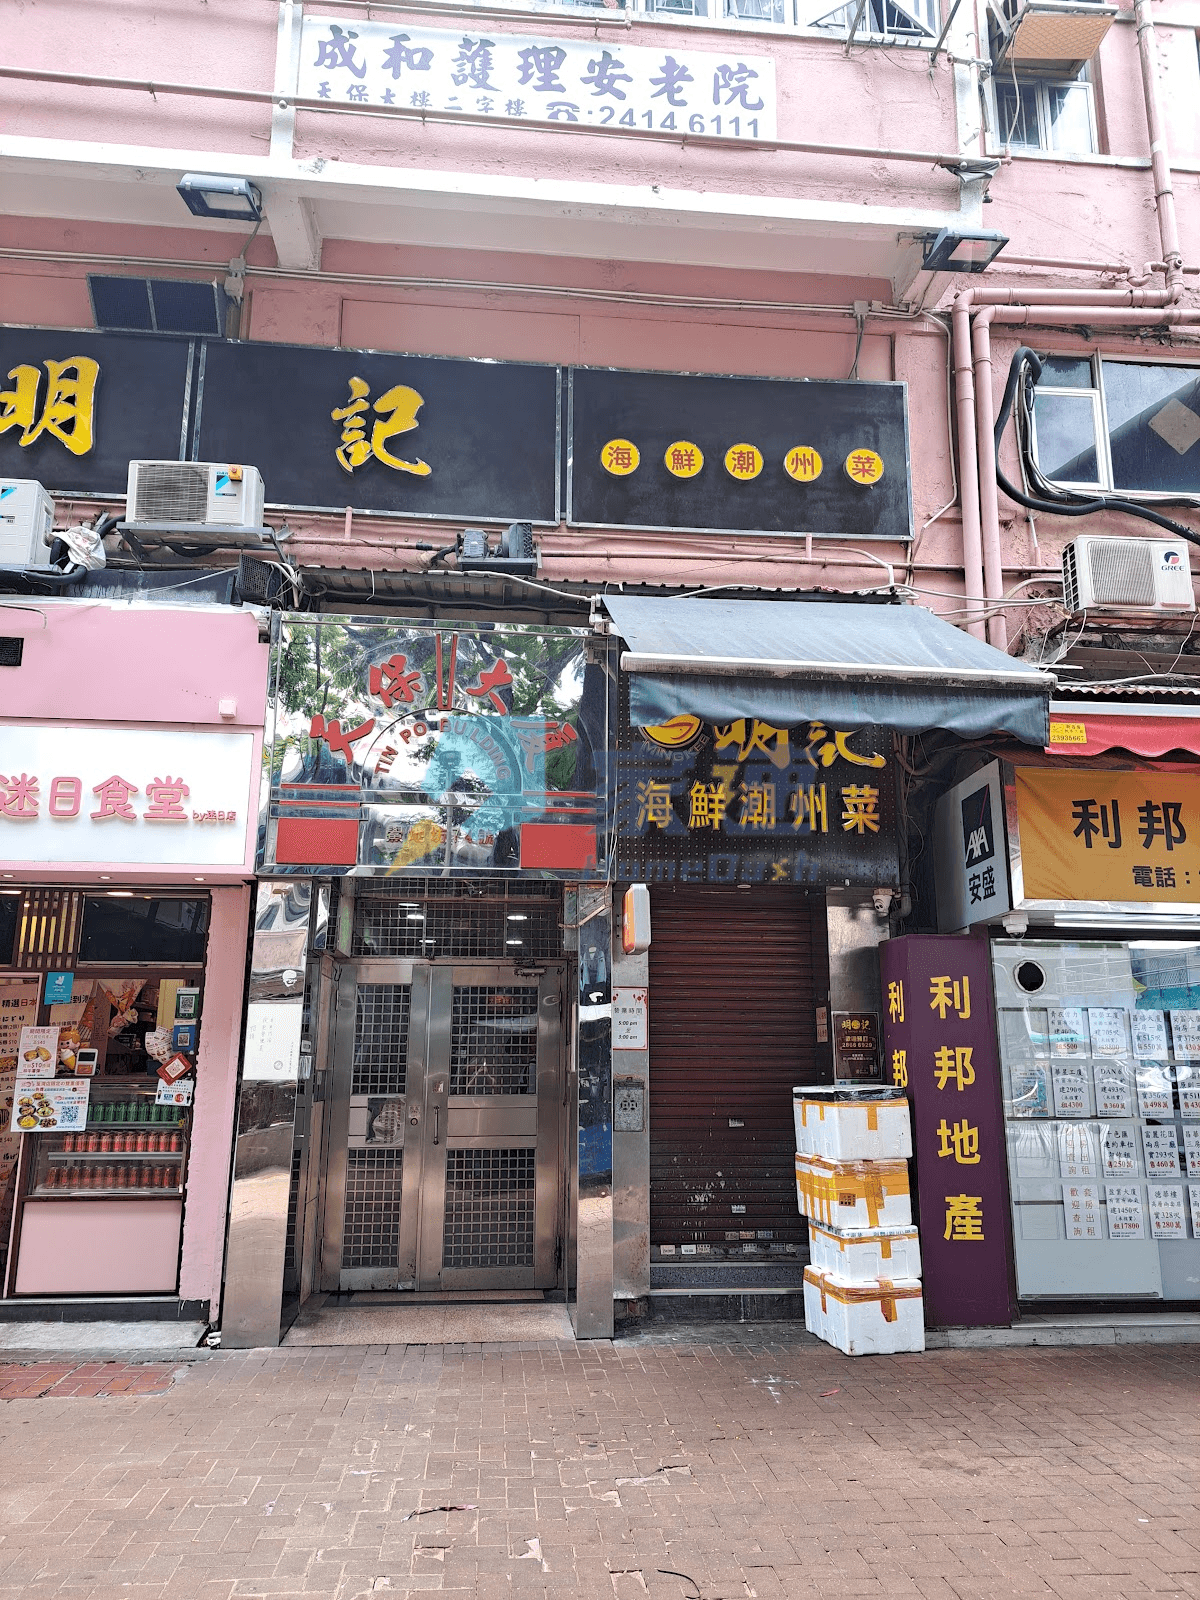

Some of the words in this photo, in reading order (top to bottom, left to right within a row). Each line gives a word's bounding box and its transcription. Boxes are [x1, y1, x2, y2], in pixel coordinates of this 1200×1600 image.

[313, 24, 765, 111] 成和護理安老院
[688, 113, 759, 138] 6111
[606, 444, 877, 478] 海鮮潮州菜
[374, 745, 399, 775] TIN
[399, 721, 428, 745] PO
[439, 717, 512, 780] BUILDING
[0, 772, 190, 820] 迷日食堂
[635, 779, 881, 835] 海鮮潮州菜
[965, 825, 990, 863] AXA
[1071, 798, 1187, 851] 利邦
[968, 865, 997, 905] 安盛
[929, 975, 985, 1241] 利邦地產
